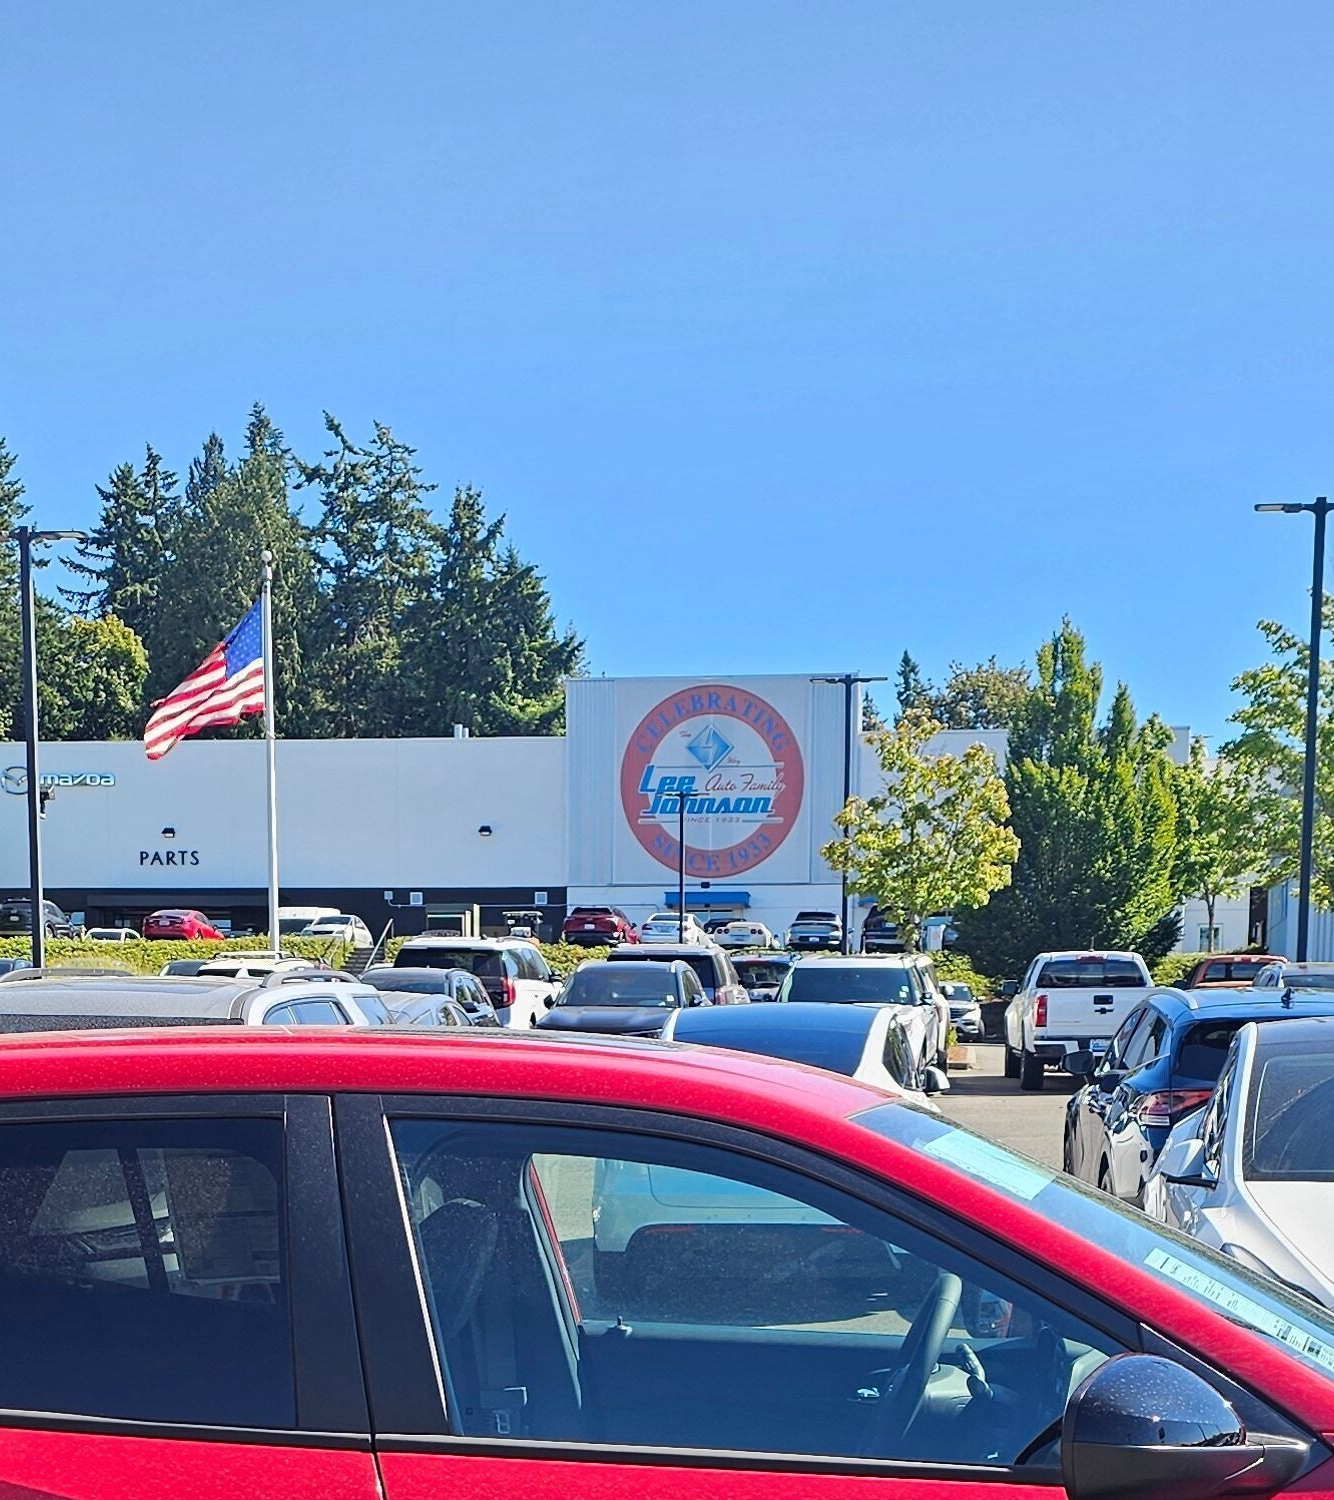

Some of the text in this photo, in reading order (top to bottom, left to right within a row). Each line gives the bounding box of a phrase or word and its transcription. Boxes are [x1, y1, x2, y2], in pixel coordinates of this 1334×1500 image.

[636, 691, 791, 753] CELEBRATING
[639, 764, 699, 794] Lee
[704, 773, 785, 797] Auto Family
[139, 850, 200, 866] PARTS
[728, 832, 773, 869] 1933
